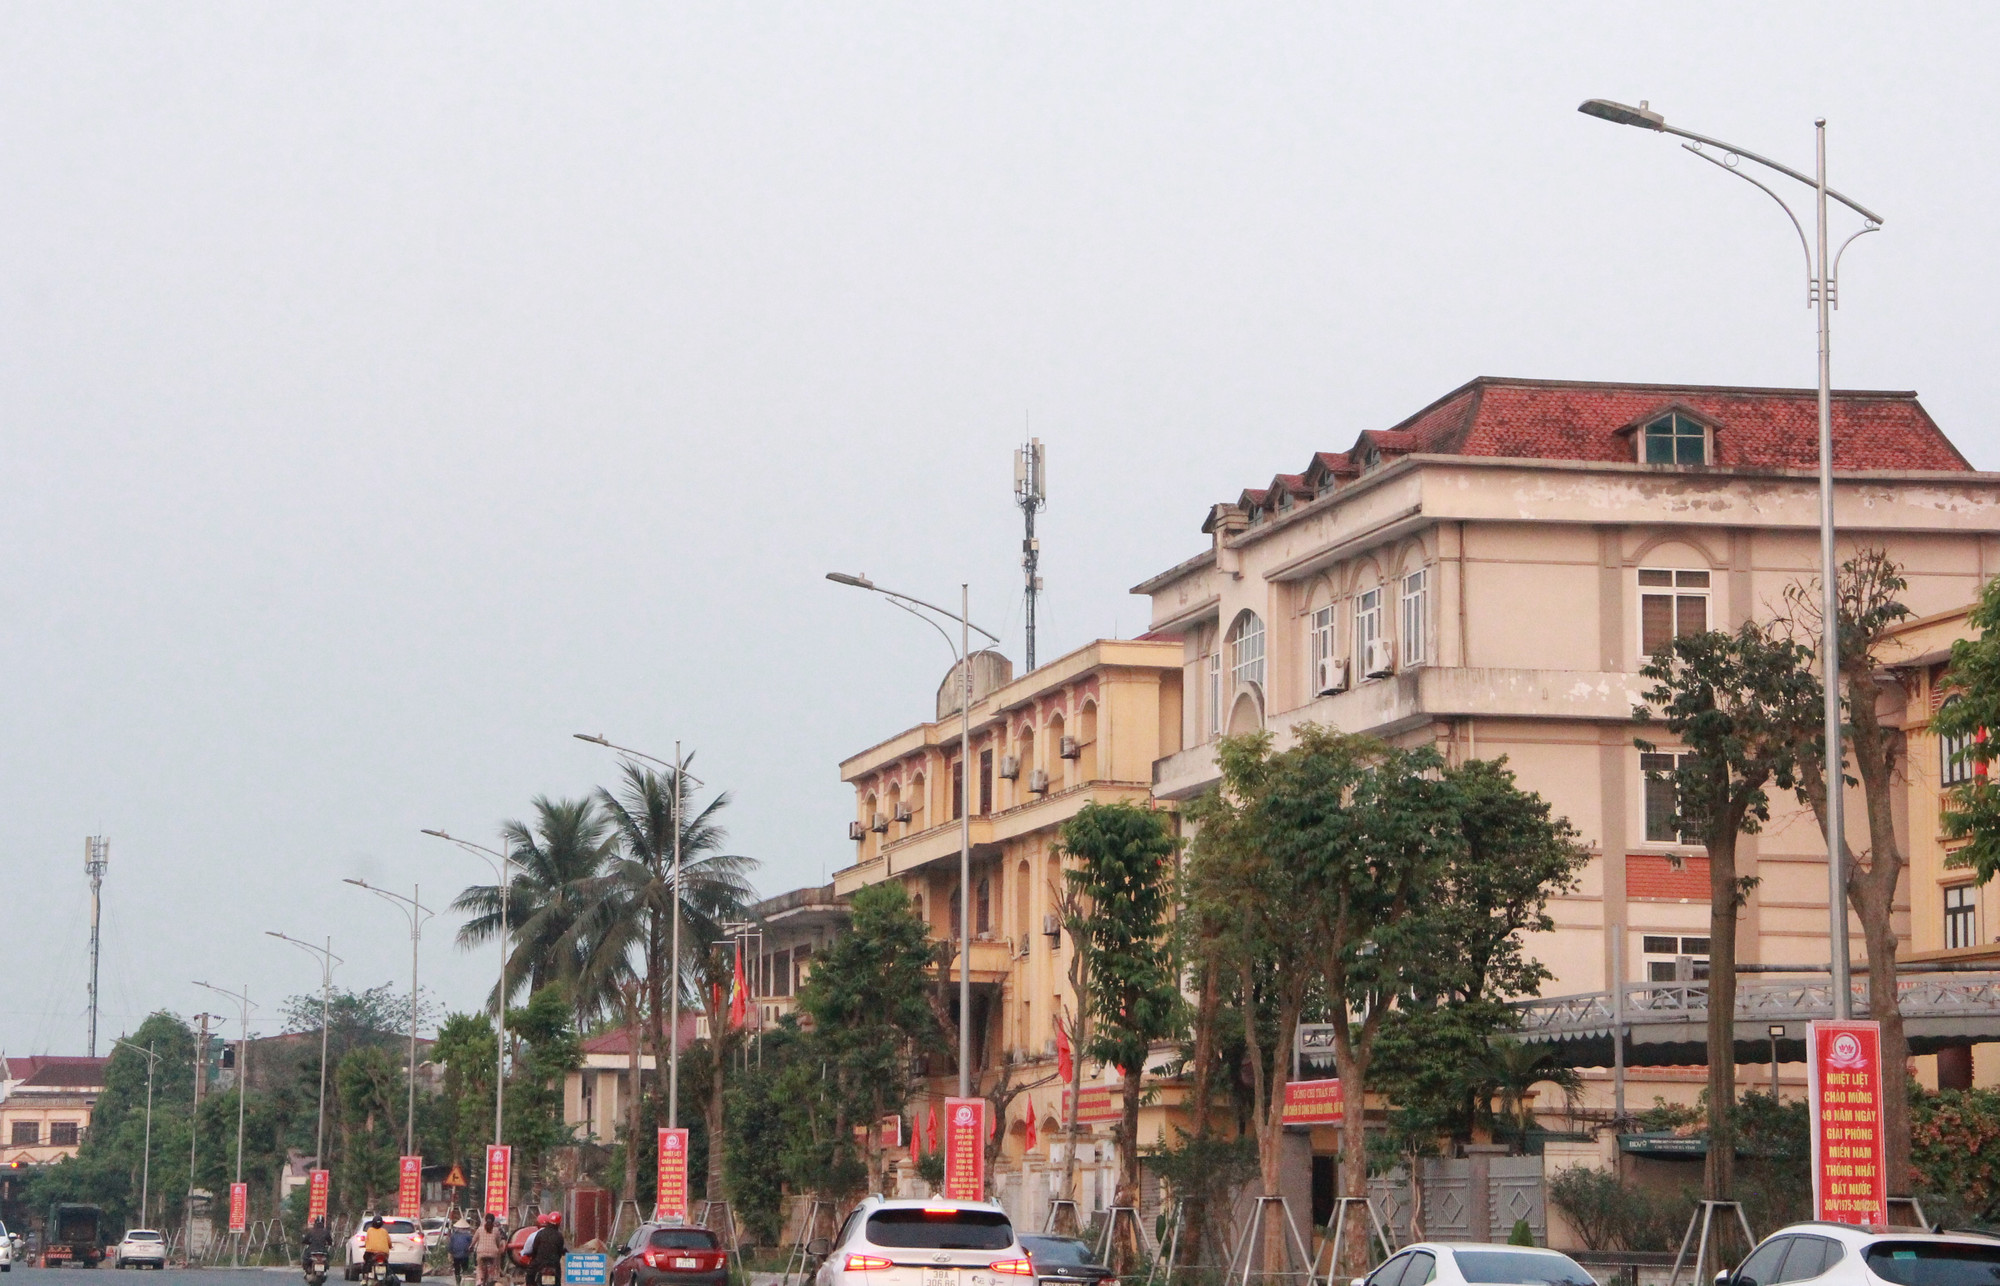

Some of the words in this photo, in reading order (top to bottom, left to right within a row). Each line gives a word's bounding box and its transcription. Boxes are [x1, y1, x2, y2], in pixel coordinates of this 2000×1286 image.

[1827, 1071, 1850, 1087] NHIỆT
[1852, 1072, 1868, 1088] LIỆT
[1824, 1089, 1846, 1103] CHÀO
[1848, 1089, 1872, 1103] MỪNG
[1834, 1107, 1853, 1121] NĂM
[1855, 1108, 1876, 1122] NGÀY
[1826, 1123, 1843, 1139] GIẢI
[1845, 1126, 1872, 1140] PHÓNG
[1829, 1142, 1850, 1158] MIỀN
[1853, 1147, 1872, 1158] NAM
[1826, 1161, 1853, 1177] THỐNG
[1855, 1162, 1876, 1177] NHẤT
[1831, 1180, 1846, 1194] ĐẤT
[1849, 1181, 1872, 1195] NƯỚC
